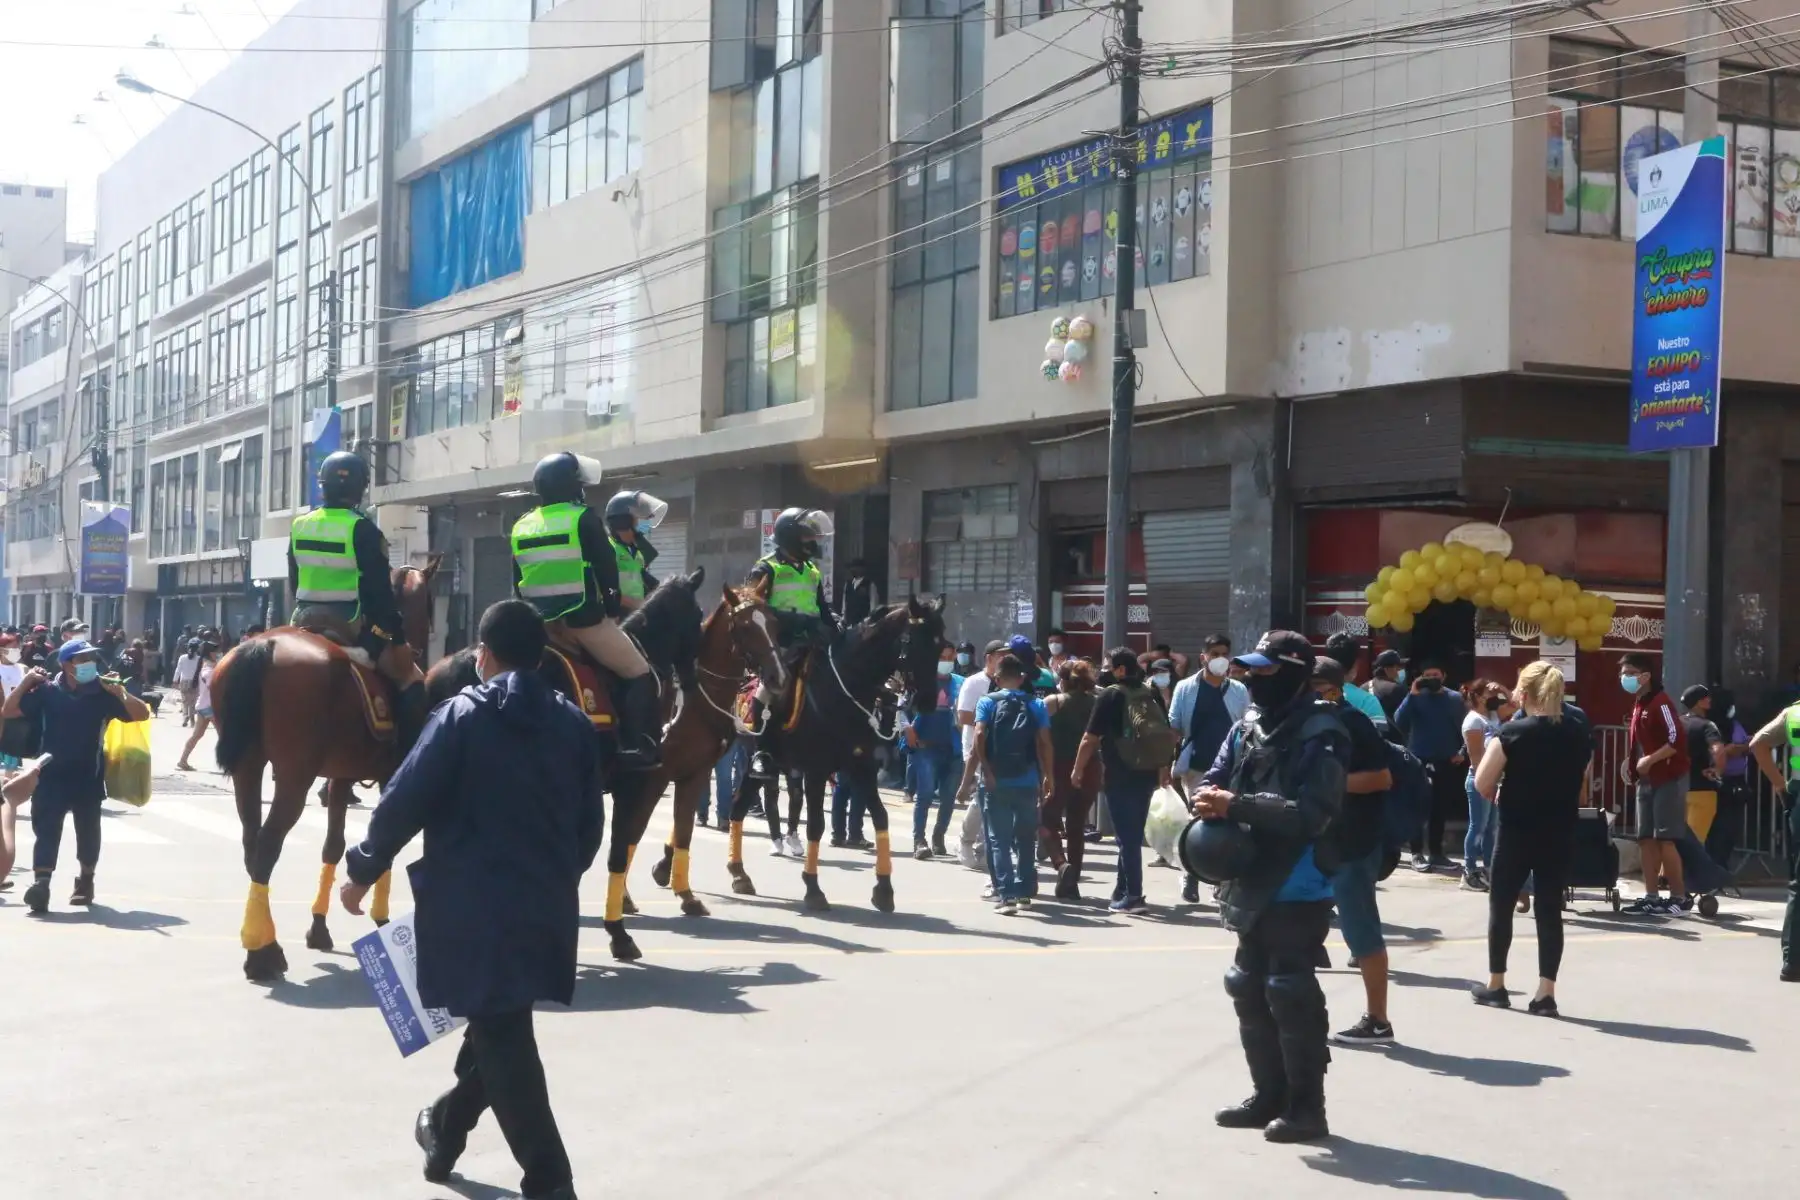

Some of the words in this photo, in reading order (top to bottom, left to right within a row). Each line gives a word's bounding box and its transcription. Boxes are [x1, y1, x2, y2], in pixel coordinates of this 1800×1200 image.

[1041, 145, 1089, 168] PELOTAS
[1640, 195, 1669, 214] LIMA
[1640, 245, 1714, 285] Compra
[1657, 336, 1690, 351] Nuestro
[1647, 349, 1701, 378] EQUIPO
[1654, 378, 1671, 393] está
[1672, 379, 1690, 394] para
[1640, 393, 1704, 418] orientarte
[426, 1007, 446, 1035] 24h
